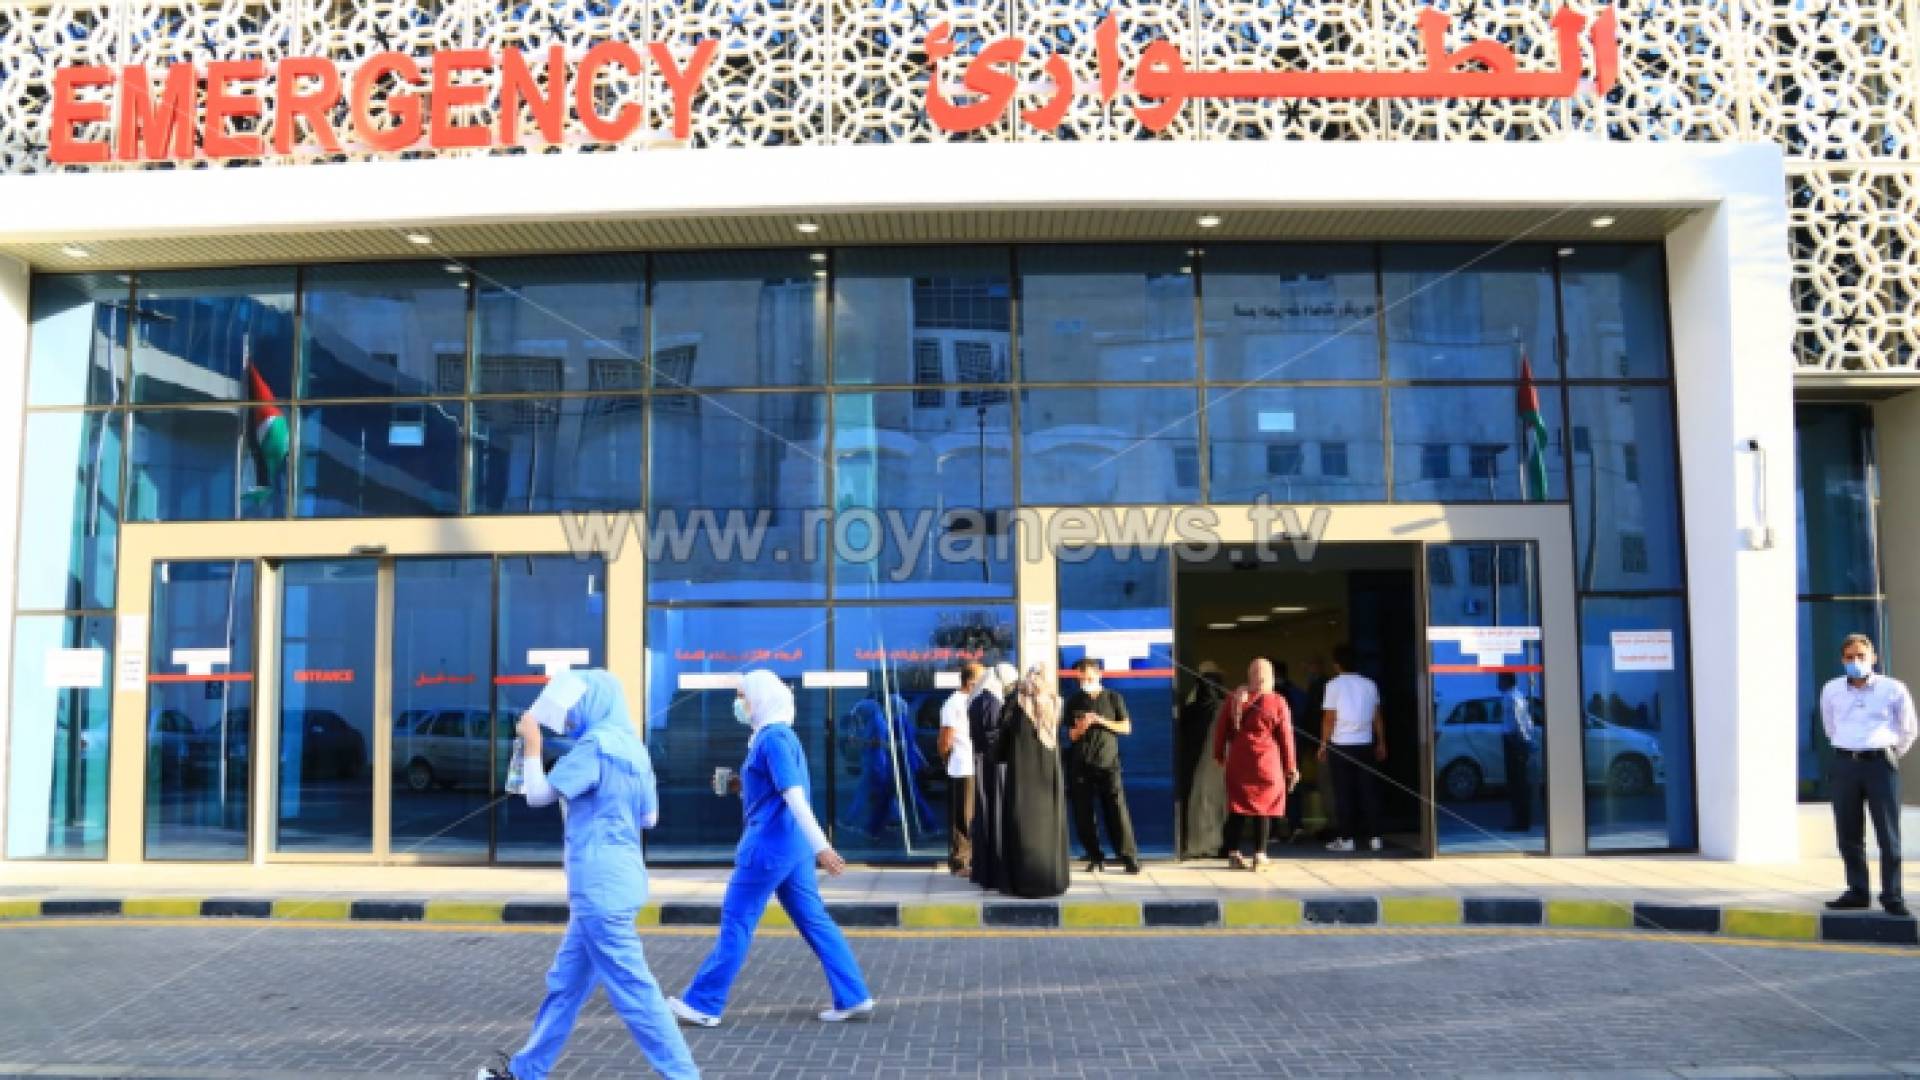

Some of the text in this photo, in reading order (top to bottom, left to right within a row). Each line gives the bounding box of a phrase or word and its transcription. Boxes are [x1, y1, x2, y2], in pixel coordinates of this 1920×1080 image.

[49, 39, 718, 164] EMERGENCY
[925, 5, 1617, 132] الطوارئ
[294, 669, 355, 683] ENTRANCE
